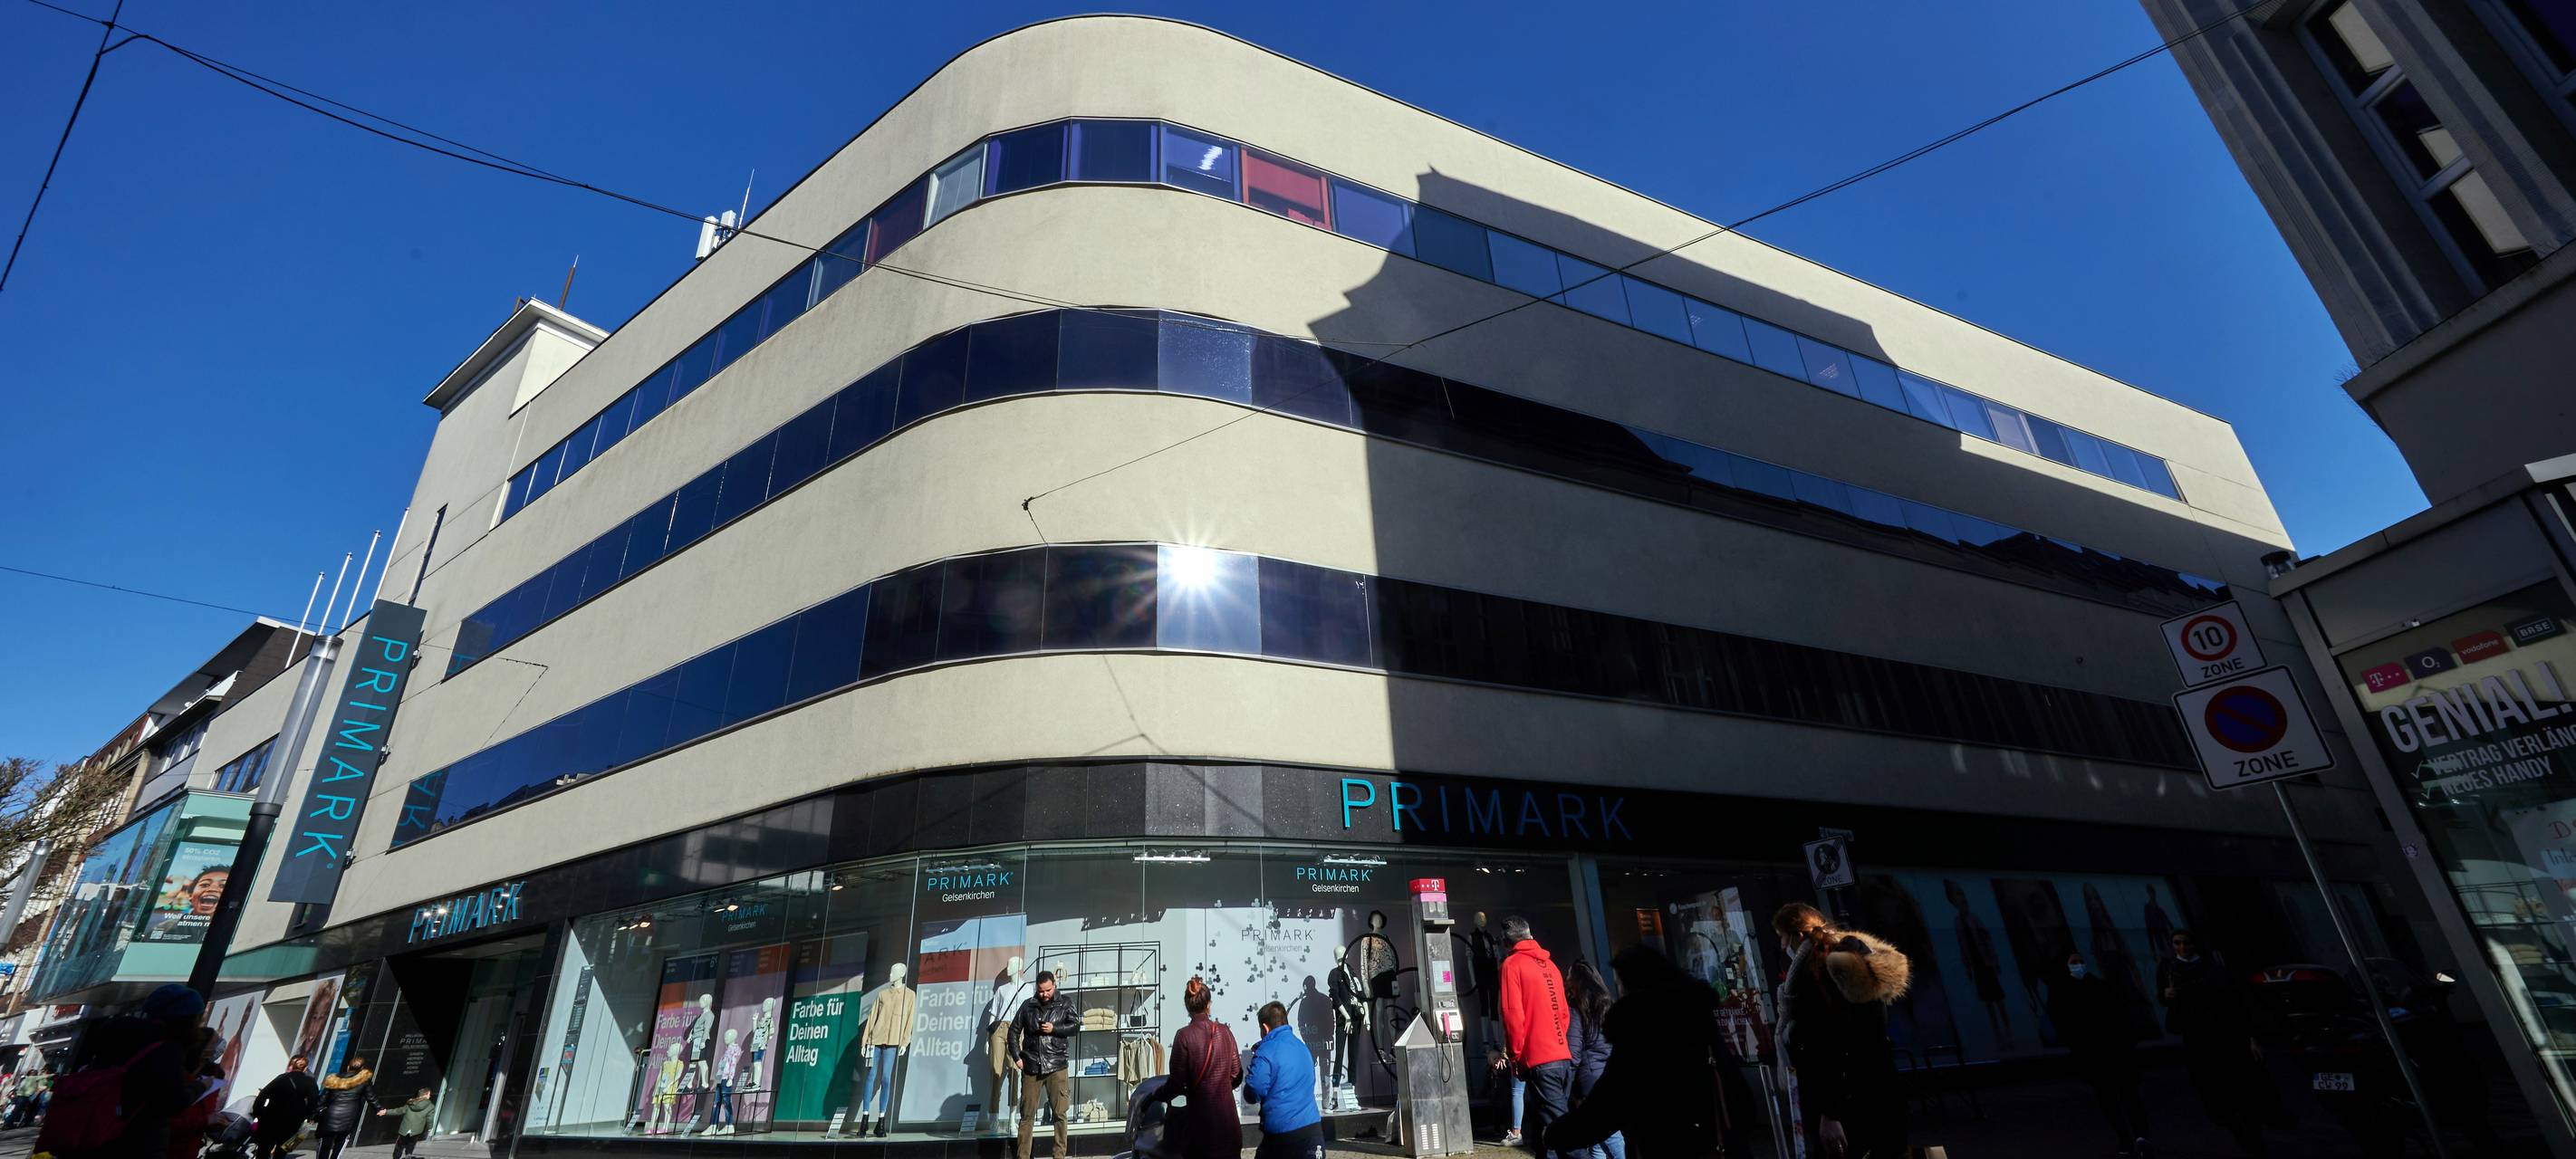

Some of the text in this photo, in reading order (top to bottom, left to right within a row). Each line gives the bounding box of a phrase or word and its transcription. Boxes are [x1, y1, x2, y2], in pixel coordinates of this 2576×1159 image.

[2193, 627, 2224, 650] 10
[2519, 620, 2552, 637] BASE
[2462, 638, 2499, 656] vodafone
[2201, 658, 2244, 678] ZONE
[2380, 661, 2573, 753] GENIAL!
[295, 636, 409, 860] PRIMARK
[2234, 750, 2299, 777] ZONE
[2427, 743, 2503, 776] VERTRAG
[2440, 755, 2553, 797] NEUES HANDY
[1341, 778, 1634, 841] PRIMARK
[927, 871, 1010, 891] PRIMARK
[1296, 867, 1370, 882] PRIMARK
[942, 890, 995, 903] Gelsenkirchen
[1312, 884, 1360, 893] Gelsenkirchen
[408, 881, 527, 943] PRIMARK
[721, 904, 767, 922] PRIMARK
[918, 985, 995, 1008] Farbe für
[1546, 979, 1559, 1011] DAVID
[793, 998, 844, 1020] Farbe für
[657, 1013, 680, 1030] Farbe
[789, 1022, 829, 1041] Deinen
[916, 1013, 976, 1031] Deinen
[785, 1044, 819, 1067] Alltag
[912, 1037, 963, 1060] Alltag
